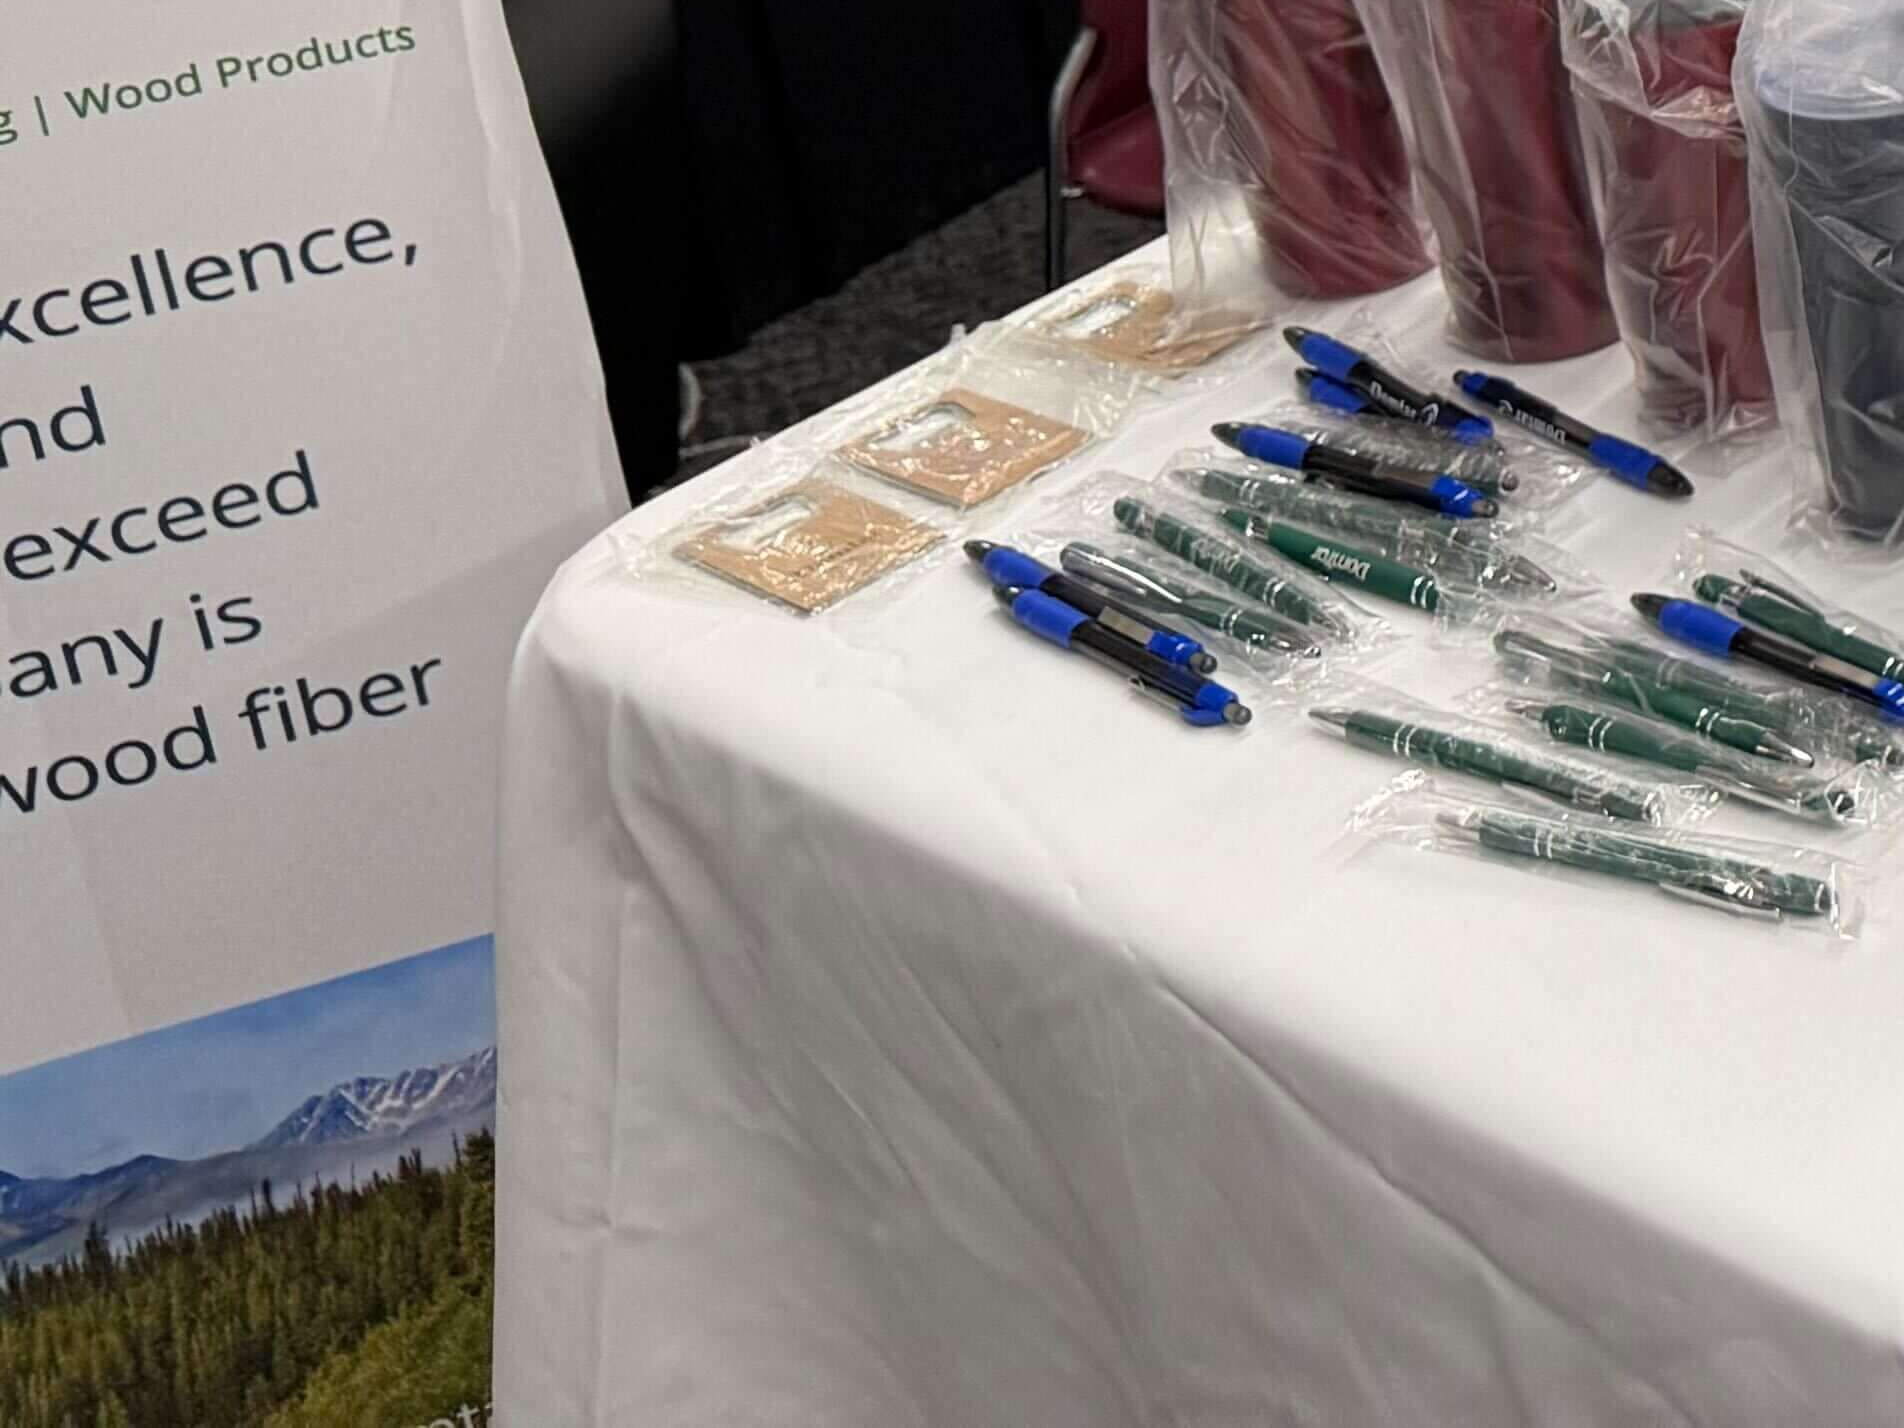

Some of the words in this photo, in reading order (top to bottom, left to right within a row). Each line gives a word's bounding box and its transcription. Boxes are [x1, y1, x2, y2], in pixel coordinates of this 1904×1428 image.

[64, 62, 204, 121] Wood
[214, 22, 418, 90] Products
[4, 449, 320, 583] exceed
[0, 617, 165, 700] any
[192, 590, 264, 656] is
[237, 655, 445, 755] fiber
